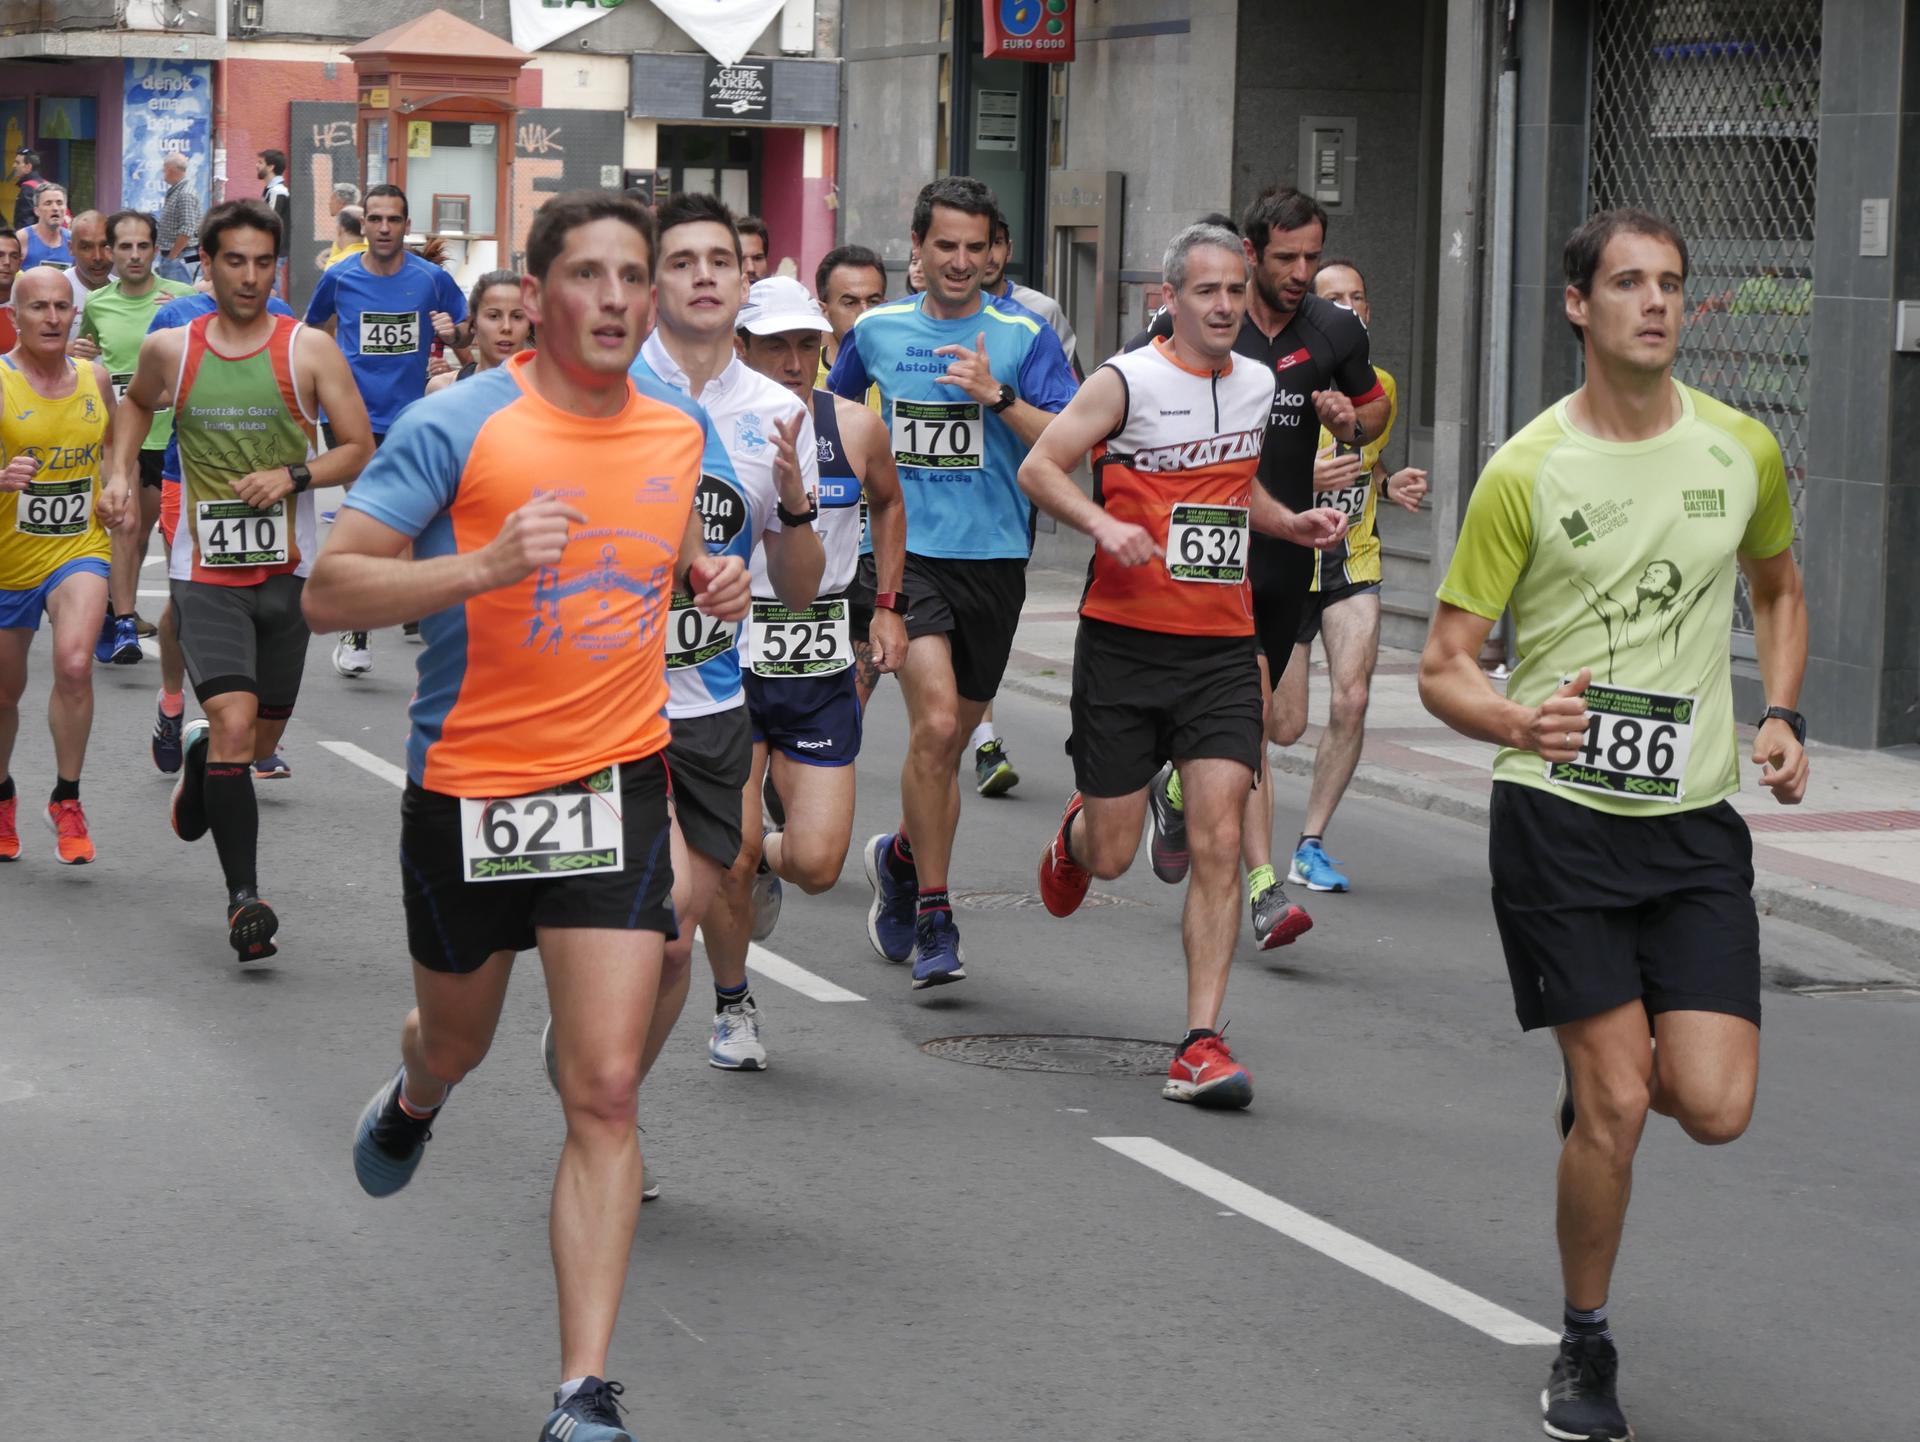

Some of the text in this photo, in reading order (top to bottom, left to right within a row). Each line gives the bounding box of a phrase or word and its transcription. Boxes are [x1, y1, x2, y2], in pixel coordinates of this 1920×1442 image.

[1003, 39, 1065, 49] EURO 6000
[143, 74, 193, 92] denok
[709, 78, 763, 89] AUKERA
[718, 69, 757, 81] GURE
[367, 324, 412, 345] 465
[905, 346, 932, 358] San
[904, 420, 971, 455] 170
[937, 456, 980, 467] KON
[929, 472, 972, 483] krosa
[1315, 488, 1365, 515] 659
[1682, 489, 1717, 500] VITORIA
[28, 494, 86, 524] 602
[208, 518, 277, 551] 410
[1180, 526, 1241, 566] 632
[762, 623, 837, 661] 525
[756, 662, 799, 674] Spiuk
[1600, 691, 1651, 704] MEMORIAL
[797, 739, 832, 749] KON
[1579, 713, 1678, 776] 486
[1552, 763, 1676, 796] Spiuk KON
[482, 796, 594, 855] 621
[473, 850, 615, 879] Spiuk KON
